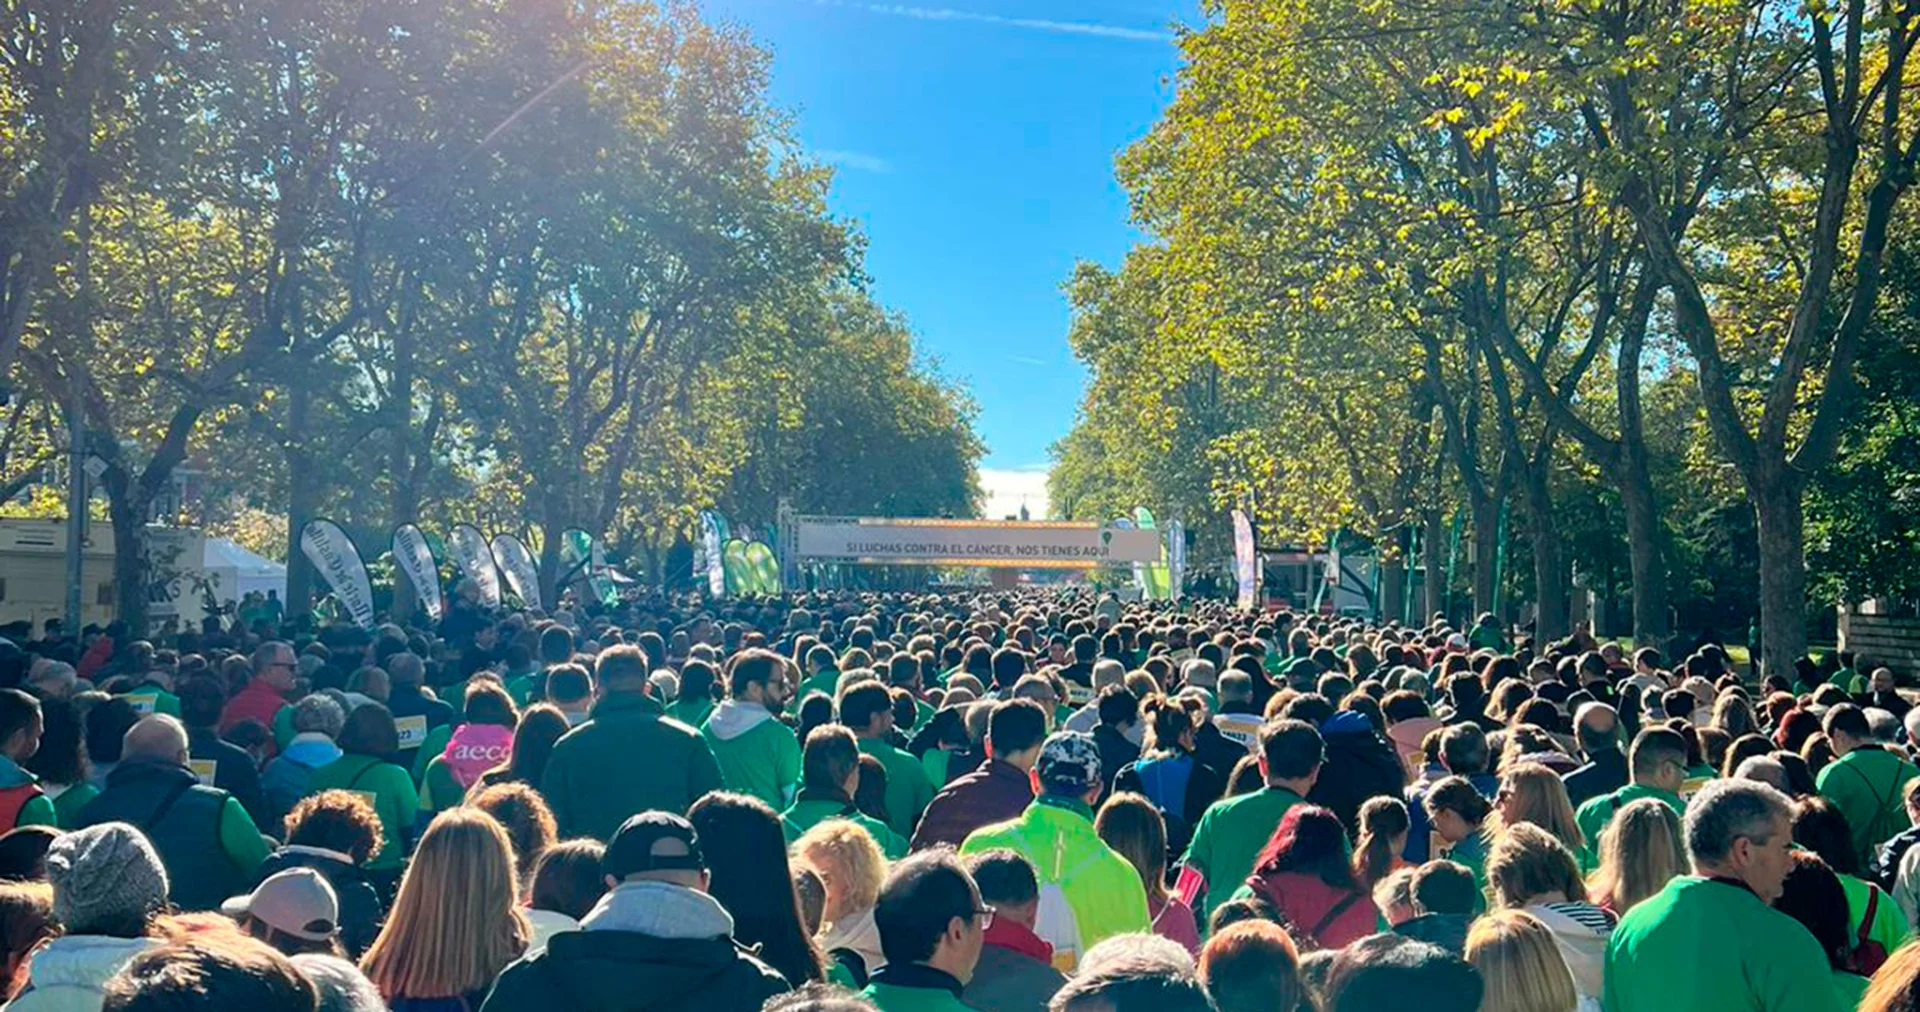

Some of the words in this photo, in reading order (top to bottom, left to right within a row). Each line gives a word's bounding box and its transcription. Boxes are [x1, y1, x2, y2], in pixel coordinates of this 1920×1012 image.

[846, 543, 857, 553] SI
[860, 543, 902, 553] LUCHAS
[904, 543, 948, 554] CONTRA
[951, 544, 963, 554] EL
[1016, 544, 1039, 556] NOS
[1042, 545, 1080, 557] TIENES
